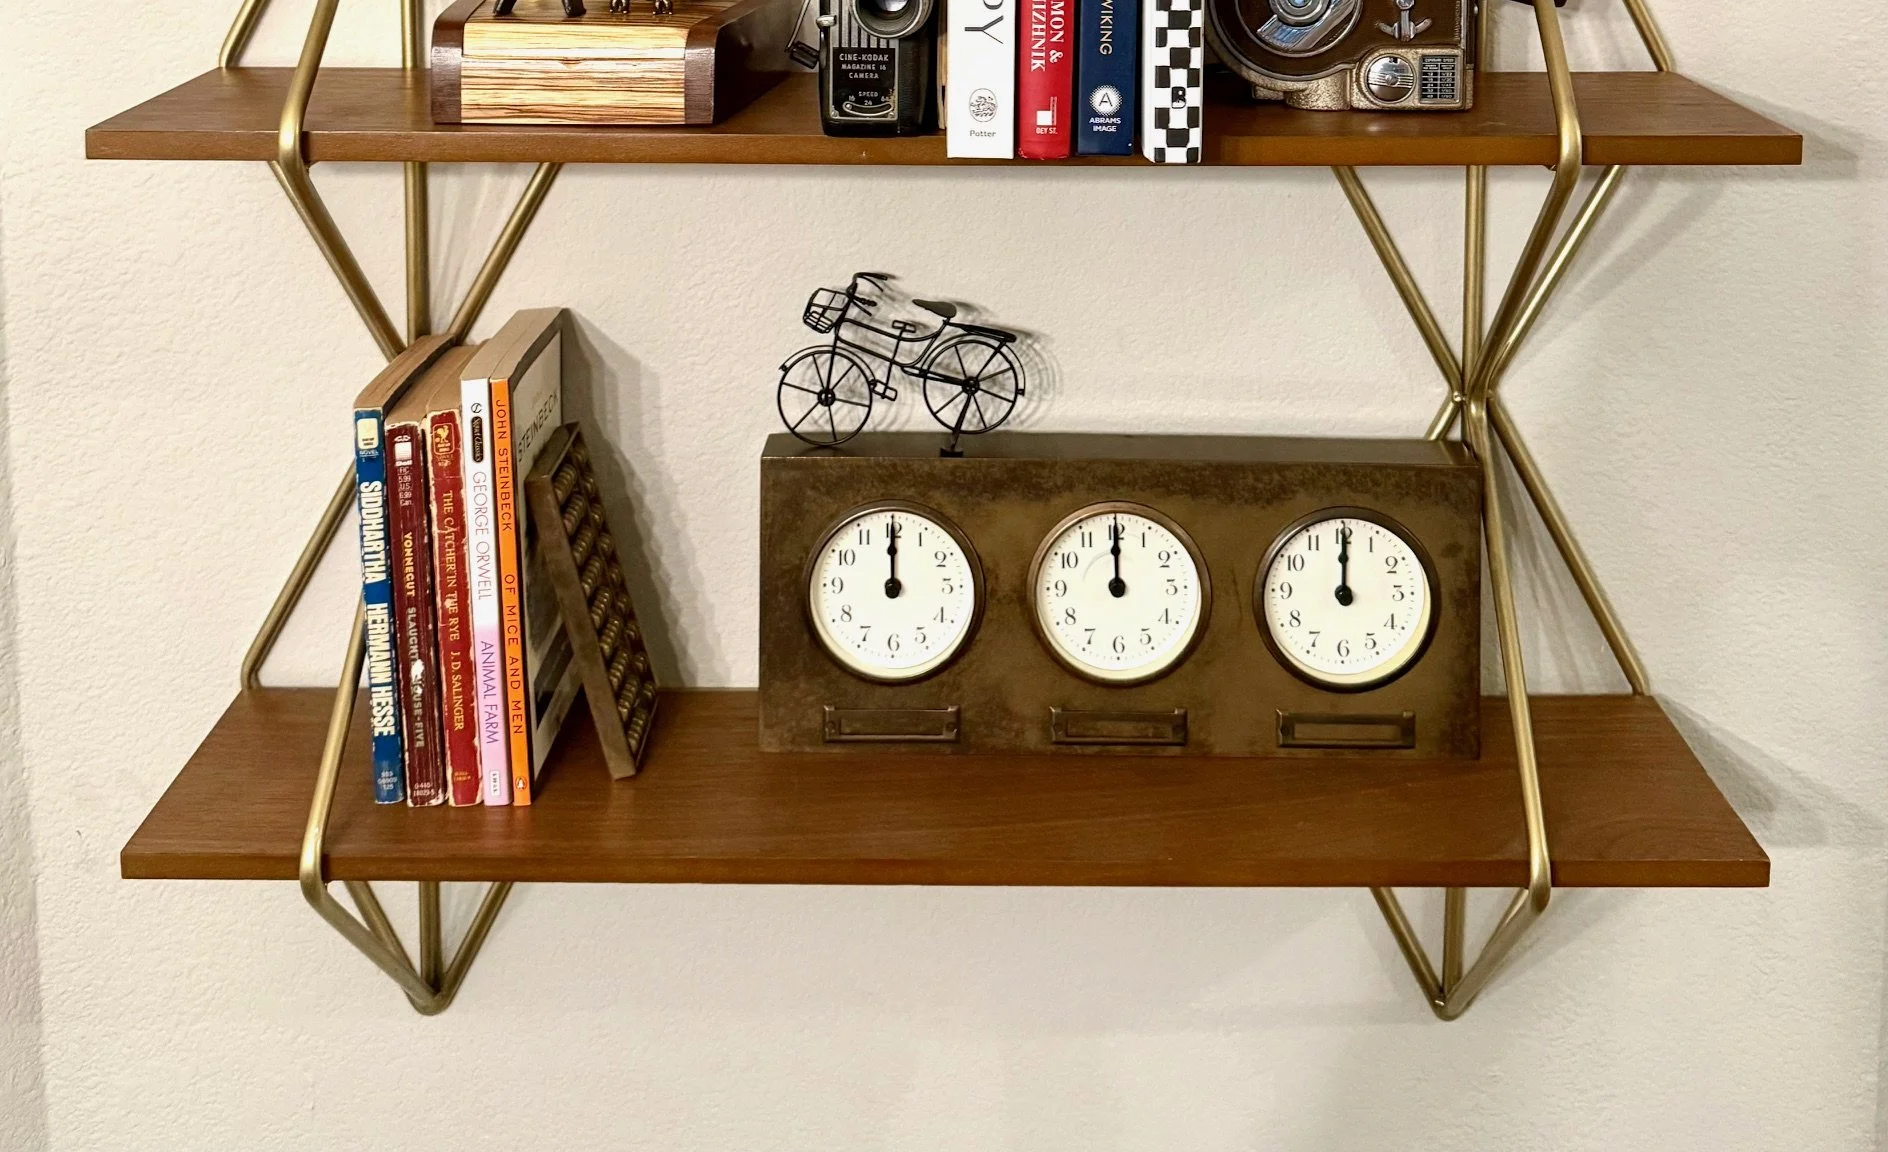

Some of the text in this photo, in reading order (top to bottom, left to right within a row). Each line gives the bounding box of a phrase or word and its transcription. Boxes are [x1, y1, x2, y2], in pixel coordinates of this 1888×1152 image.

[1050, 49, 1064, 63] &
[518, 392, 558, 462] STEINBECK
[442, 490, 454, 514] THE
[360, 480, 387, 584] SIDDHARTHA
[858, 528, 871, 546] 11
[918, 532, 923, 547] 1
[1080, 532, 1092, 548] 11
[1141, 532, 1146, 548] 1
[444, 517, 456, 574] CATCHER
[1308, 535, 1320, 551] 11
[1368, 536, 1374, 552] 1
[496, 400, 524, 734] JOHN STEINBECK OF MICE AND MEN
[838, 551, 856, 566] 10
[934, 551, 947, 568] 2
[1061, 552, 1078, 568] 10
[1158, 551, 1170, 568] 2
[1287, 554, 1304, 572] 10
[1386, 556, 1398, 574] 2
[447, 574, 457, 588] IN
[832, 577, 844, 594] 9
[942, 578, 954, 594] 3
[1054, 580, 1067, 597] 9
[1166, 579, 1178, 596] 3
[1280, 582, 1292, 600] 9
[1393, 584, 1405, 602] 3
[446, 591, 458, 614] THE
[473, 472, 499, 744] GEORGE ORWELL ANIMAL FARM
[840, 604, 852, 623] 8
[934, 607, 948, 623] 4
[1065, 608, 1076, 625] 8
[1158, 608, 1171, 625] 4
[1290, 610, 1301, 628] 8
[1384, 613, 1398, 630] 4
[449, 618, 460, 642] RYE
[860, 626, 872, 642] 7
[914, 626, 926, 644] 5
[1084, 628, 1096, 646] 7
[1140, 628, 1152, 646] 5
[1309, 631, 1320, 647] 7
[367, 602, 392, 684] HERMANN
[888, 634, 900, 652] 6
[1113, 636, 1126, 654] 6
[1337, 639, 1350, 657] 6
[1364, 632, 1376, 650] 5
[371, 686, 396, 737] HESSE
[452, 674, 464, 732] SALINGER
